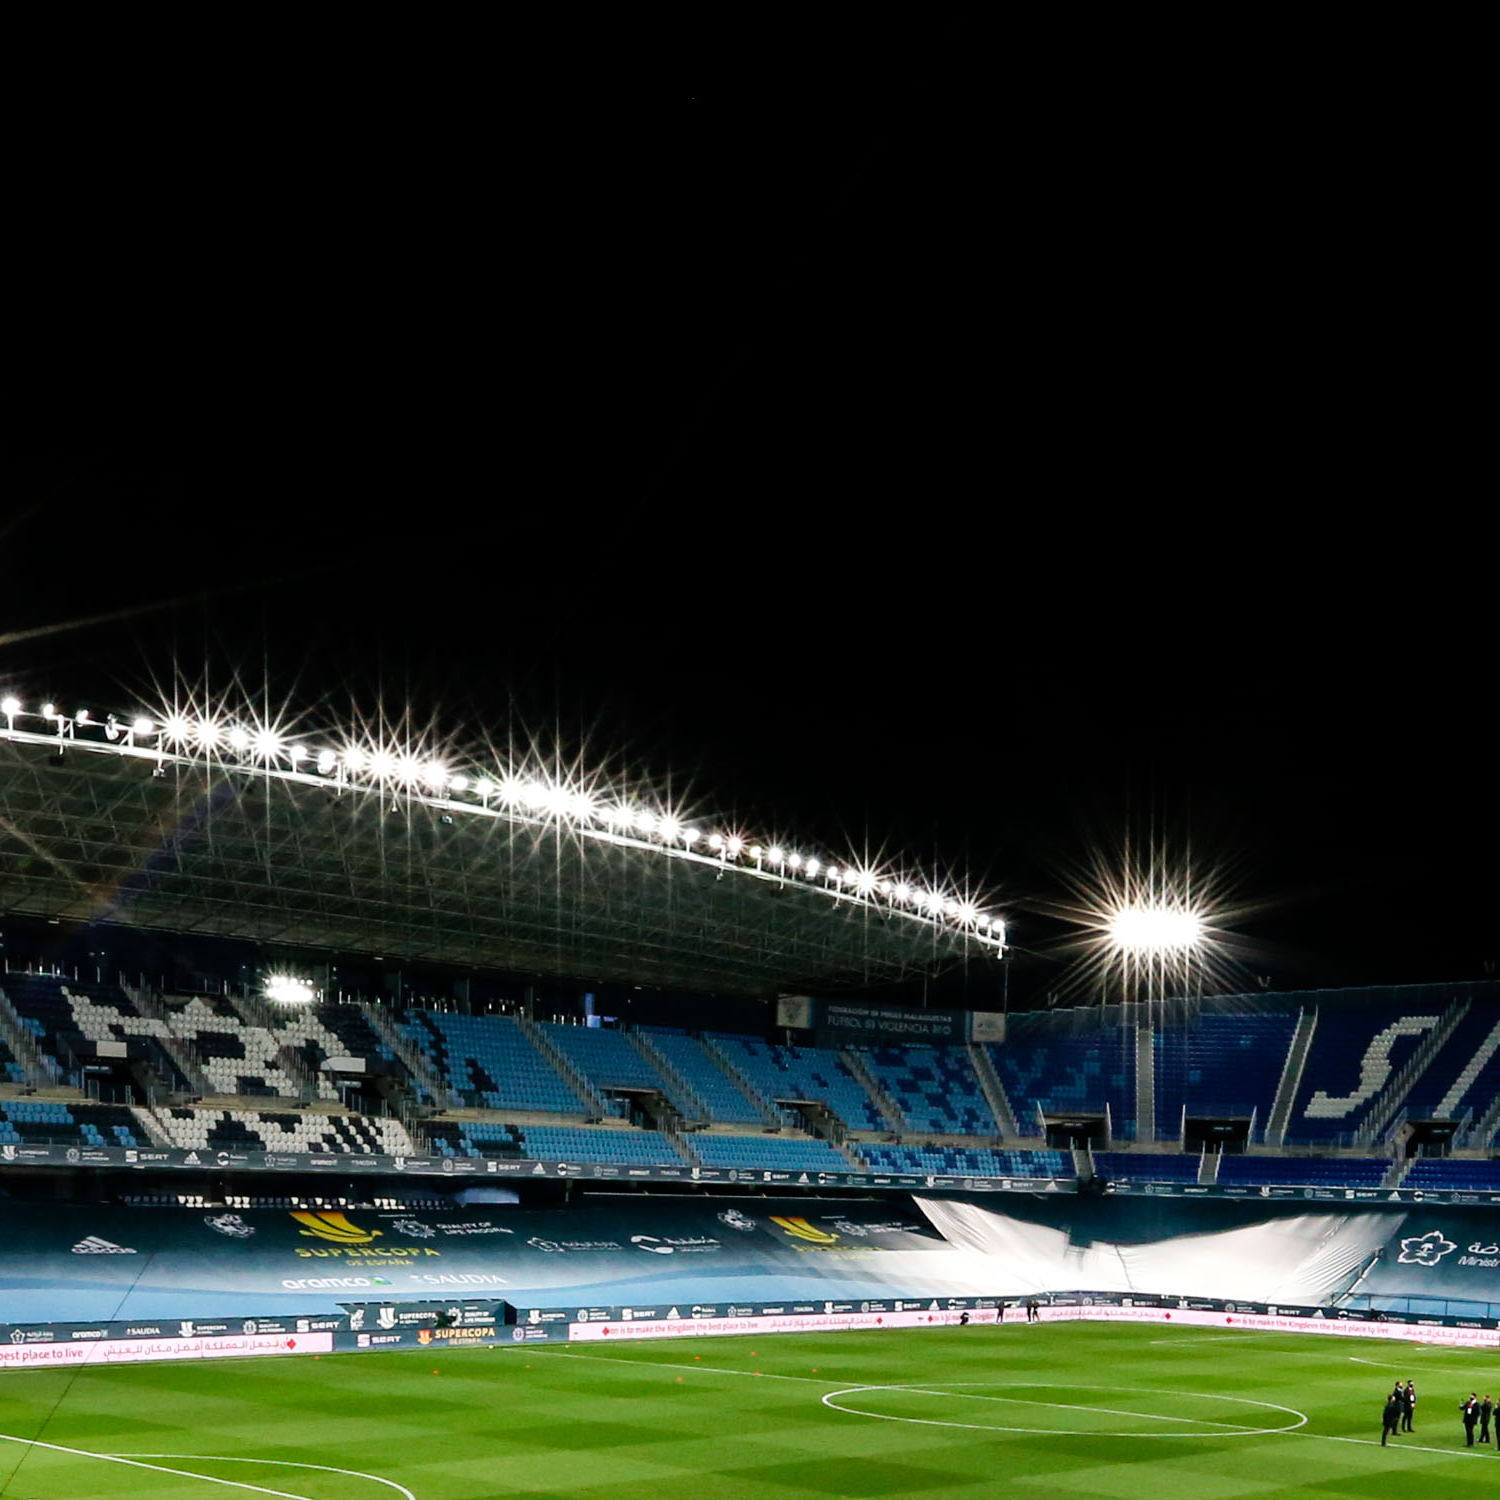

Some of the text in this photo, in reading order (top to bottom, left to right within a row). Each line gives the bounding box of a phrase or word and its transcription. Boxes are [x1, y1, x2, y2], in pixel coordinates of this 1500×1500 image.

[139, 1153, 169, 1161] SEAT
[71, 1246, 137, 1255] adidas
[294, 1247, 441, 1258] SUPERCOPA
[282, 1276, 371, 1290] aramco
[423, 1273, 507, 1286] SAUDIA
[311, 1321, 339, 1329] SEAT
[72, 1330, 101, 1339] aramco
[130, 1327, 161, 1335] SAUDIA
[435, 1328, 495, 1339] SUPERCOPA
[372, 1335, 401, 1344] SEAT
[22, 1349, 54, 1361] place
[56, 1349, 63, 1358] to
[65, 1347, 83, 1358] live
